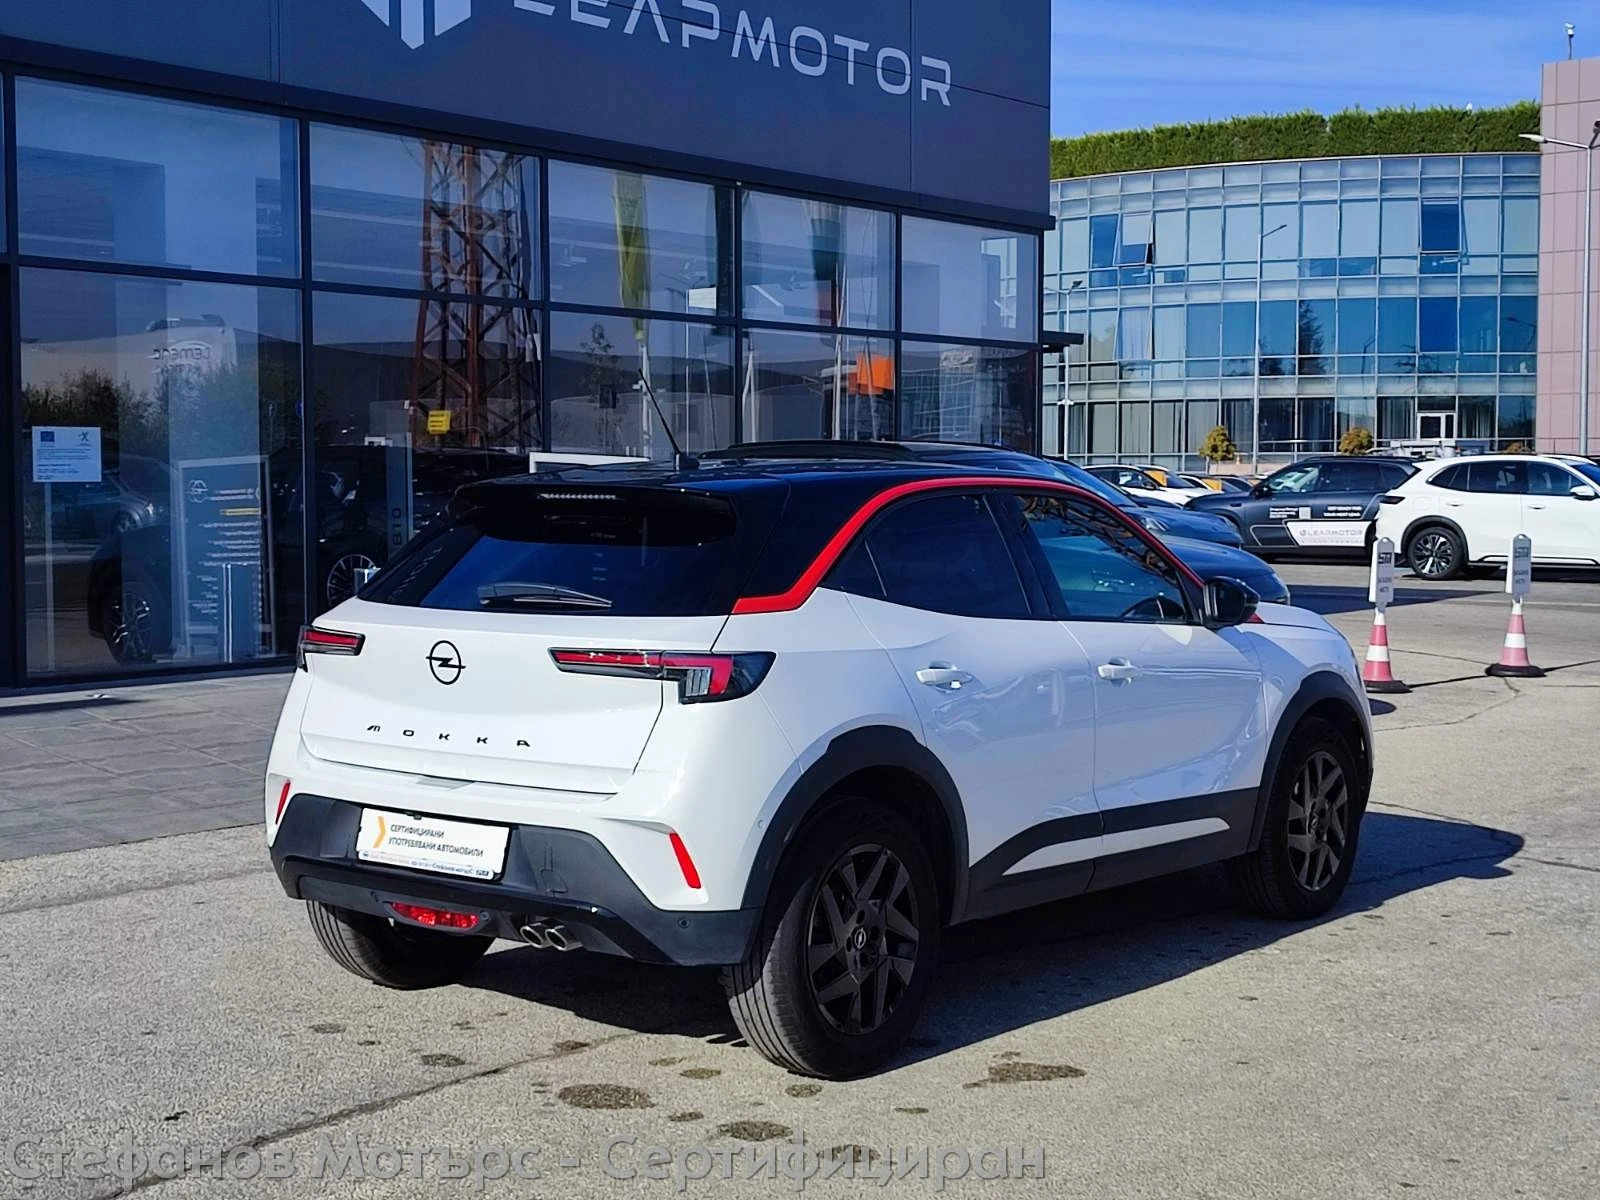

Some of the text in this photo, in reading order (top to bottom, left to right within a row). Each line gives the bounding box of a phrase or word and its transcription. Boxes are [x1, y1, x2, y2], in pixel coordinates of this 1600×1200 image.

[514, 0, 952, 107] EAPMOTOR
[367, 725, 530, 747] MOKKA
[390, 823, 445, 839] СЕРТИФИЦИРАНИ
[436, 843, 484, 857] АВТОМОБИЛИ
